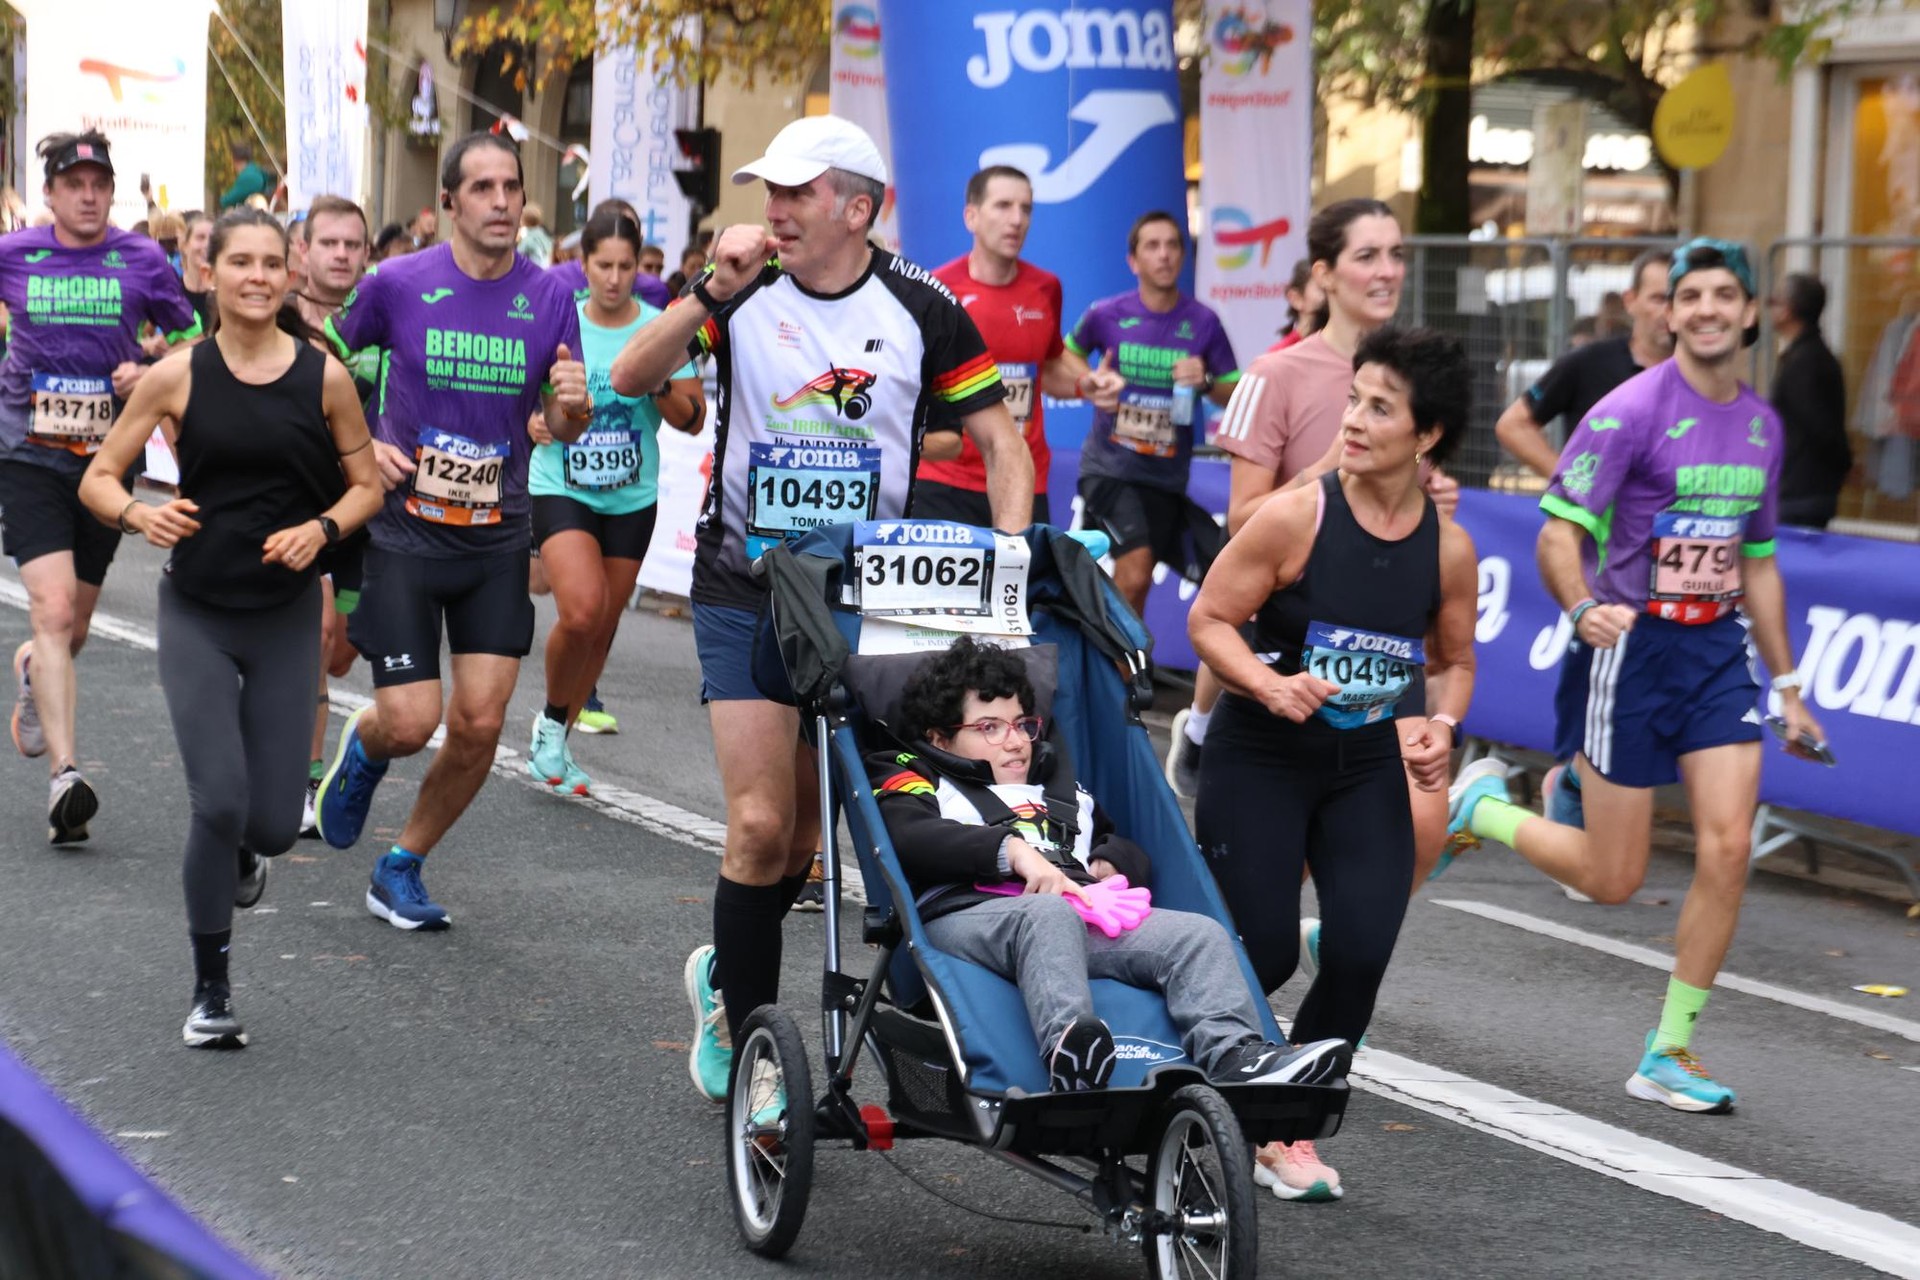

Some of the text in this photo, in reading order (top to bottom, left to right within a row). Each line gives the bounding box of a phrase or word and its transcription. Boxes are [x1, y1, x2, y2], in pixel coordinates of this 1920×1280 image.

[966, 8, 1173, 89] Joma
[27, 274, 122, 300] BEHOBIA
[425, 327, 526, 366] BEHOBIA
[426, 358, 454, 377] SAN
[457, 361, 526, 385] SEBASTIÁN
[59, 377, 105, 394] Joma
[40, 397, 111, 421] 13718
[424, 454, 500, 486] 12240
[571, 447, 636, 471] 9398
[788, 447, 861, 469] Joma
[448, 487, 472, 500] IKER
[760, 475, 867, 511] 10493
[790, 516, 834, 528] TOMAS
[897, 523, 974, 545] Joma
[865, 554, 980, 587] 31062
[1003, 583, 1023, 634] 31062
[1347, 632, 1413, 659] Joma
[1313, 655, 1407, 686] 10494
